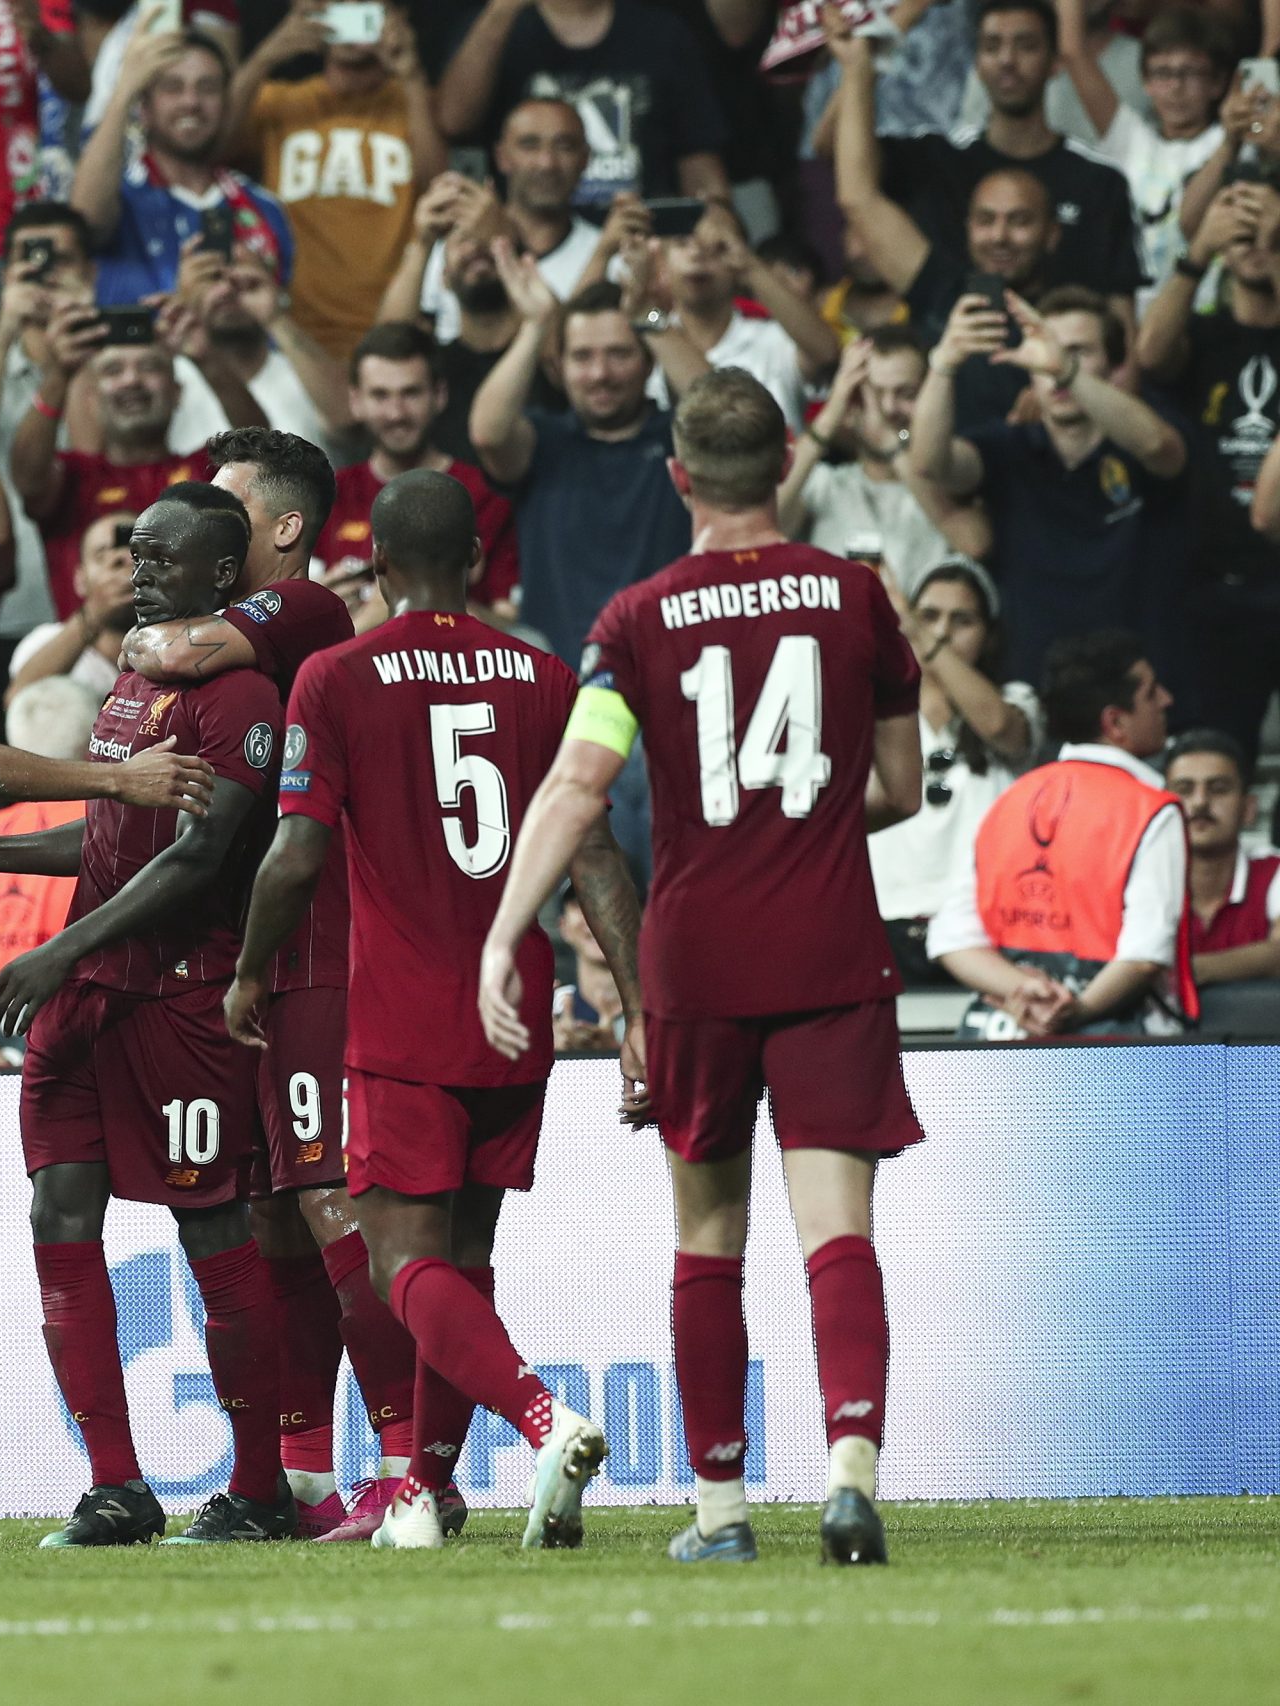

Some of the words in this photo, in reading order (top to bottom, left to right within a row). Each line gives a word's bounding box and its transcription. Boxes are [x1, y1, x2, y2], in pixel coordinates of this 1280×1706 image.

[279, 127, 413, 207] GAP
[660, 574, 841, 630] HENDERSON
[372, 647, 537, 686] WIJNALDUM
[680, 635, 832, 827] 14
[429, 701, 511, 880] 5
[162, 1098, 220, 1165] 10
[289, 1072, 322, 1142] 9
